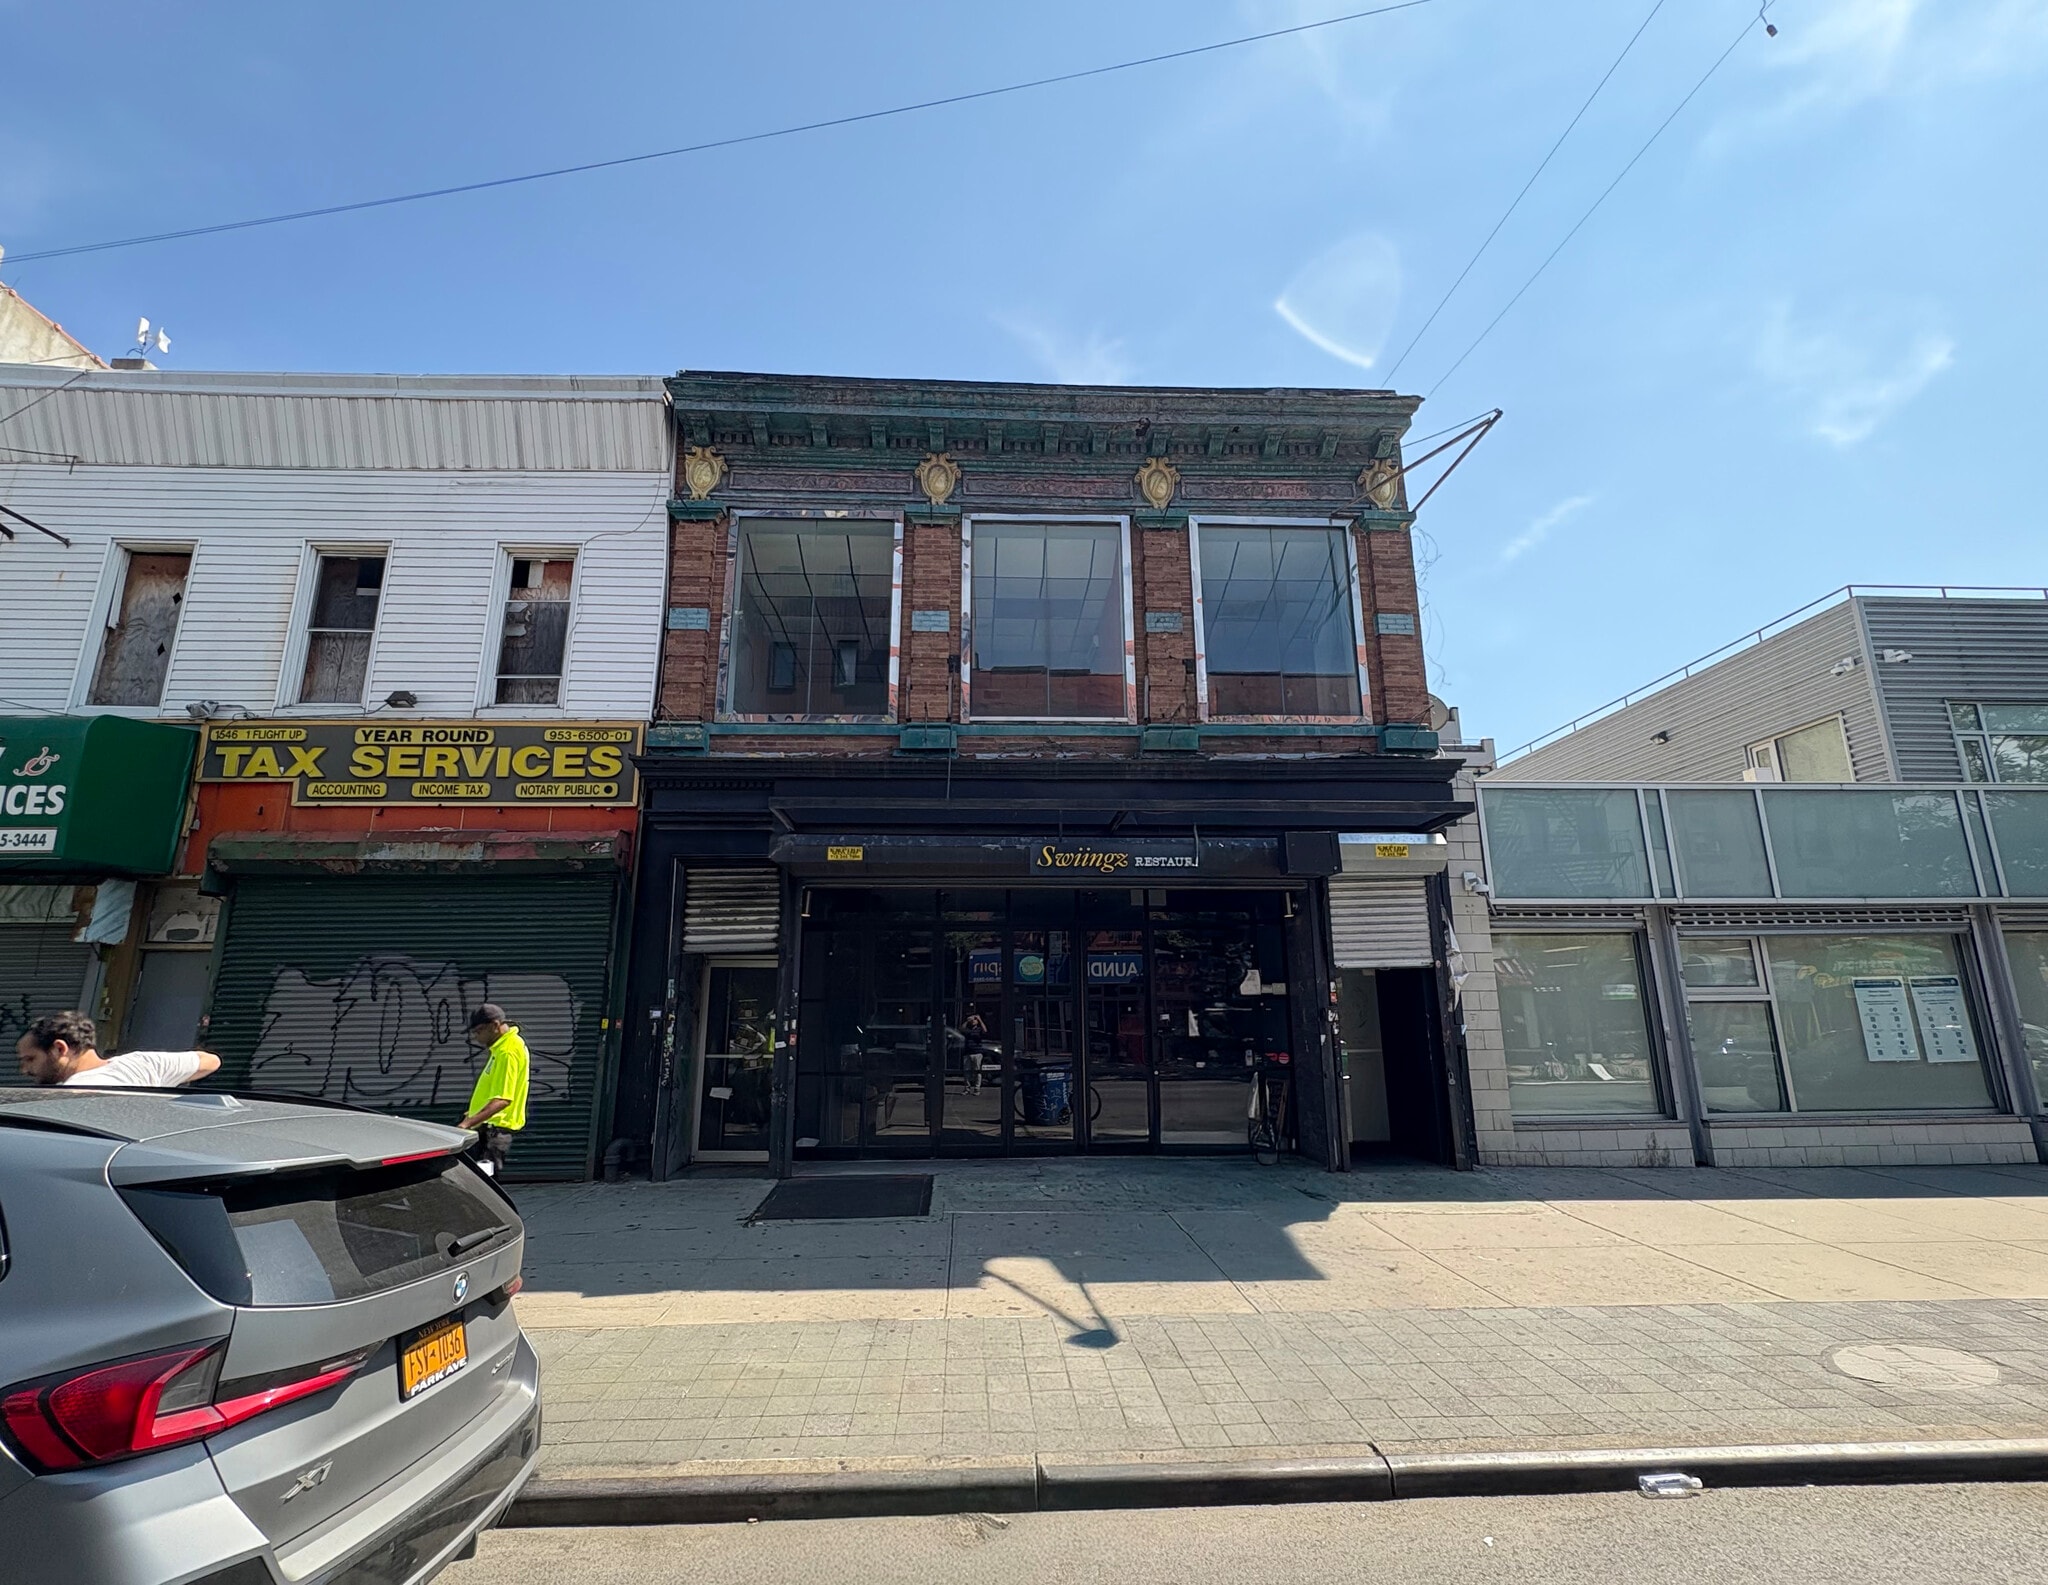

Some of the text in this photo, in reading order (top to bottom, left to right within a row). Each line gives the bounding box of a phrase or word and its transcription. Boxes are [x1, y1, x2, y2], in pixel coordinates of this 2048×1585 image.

[215, 729, 238, 740] 1546
[252, 730, 286, 740] FLIGHT
[289, 729, 303, 740] UP
[361, 729, 489, 743] YEAR ROUND
[549, 731, 629, 741] 953-6500-01
[215, 745, 623, 778] TAX SERVICES
[312, 784, 381, 795] ACCOUNTING
[418, 784, 484, 795] INCOME TAX
[519, 784, 600, 795] NOTARY PUBLIC
[1036, 845, 1129, 873] Swiingz
[410, 1369, 445, 1397] PARK
[445, 1357, 468, 1376] AVE
